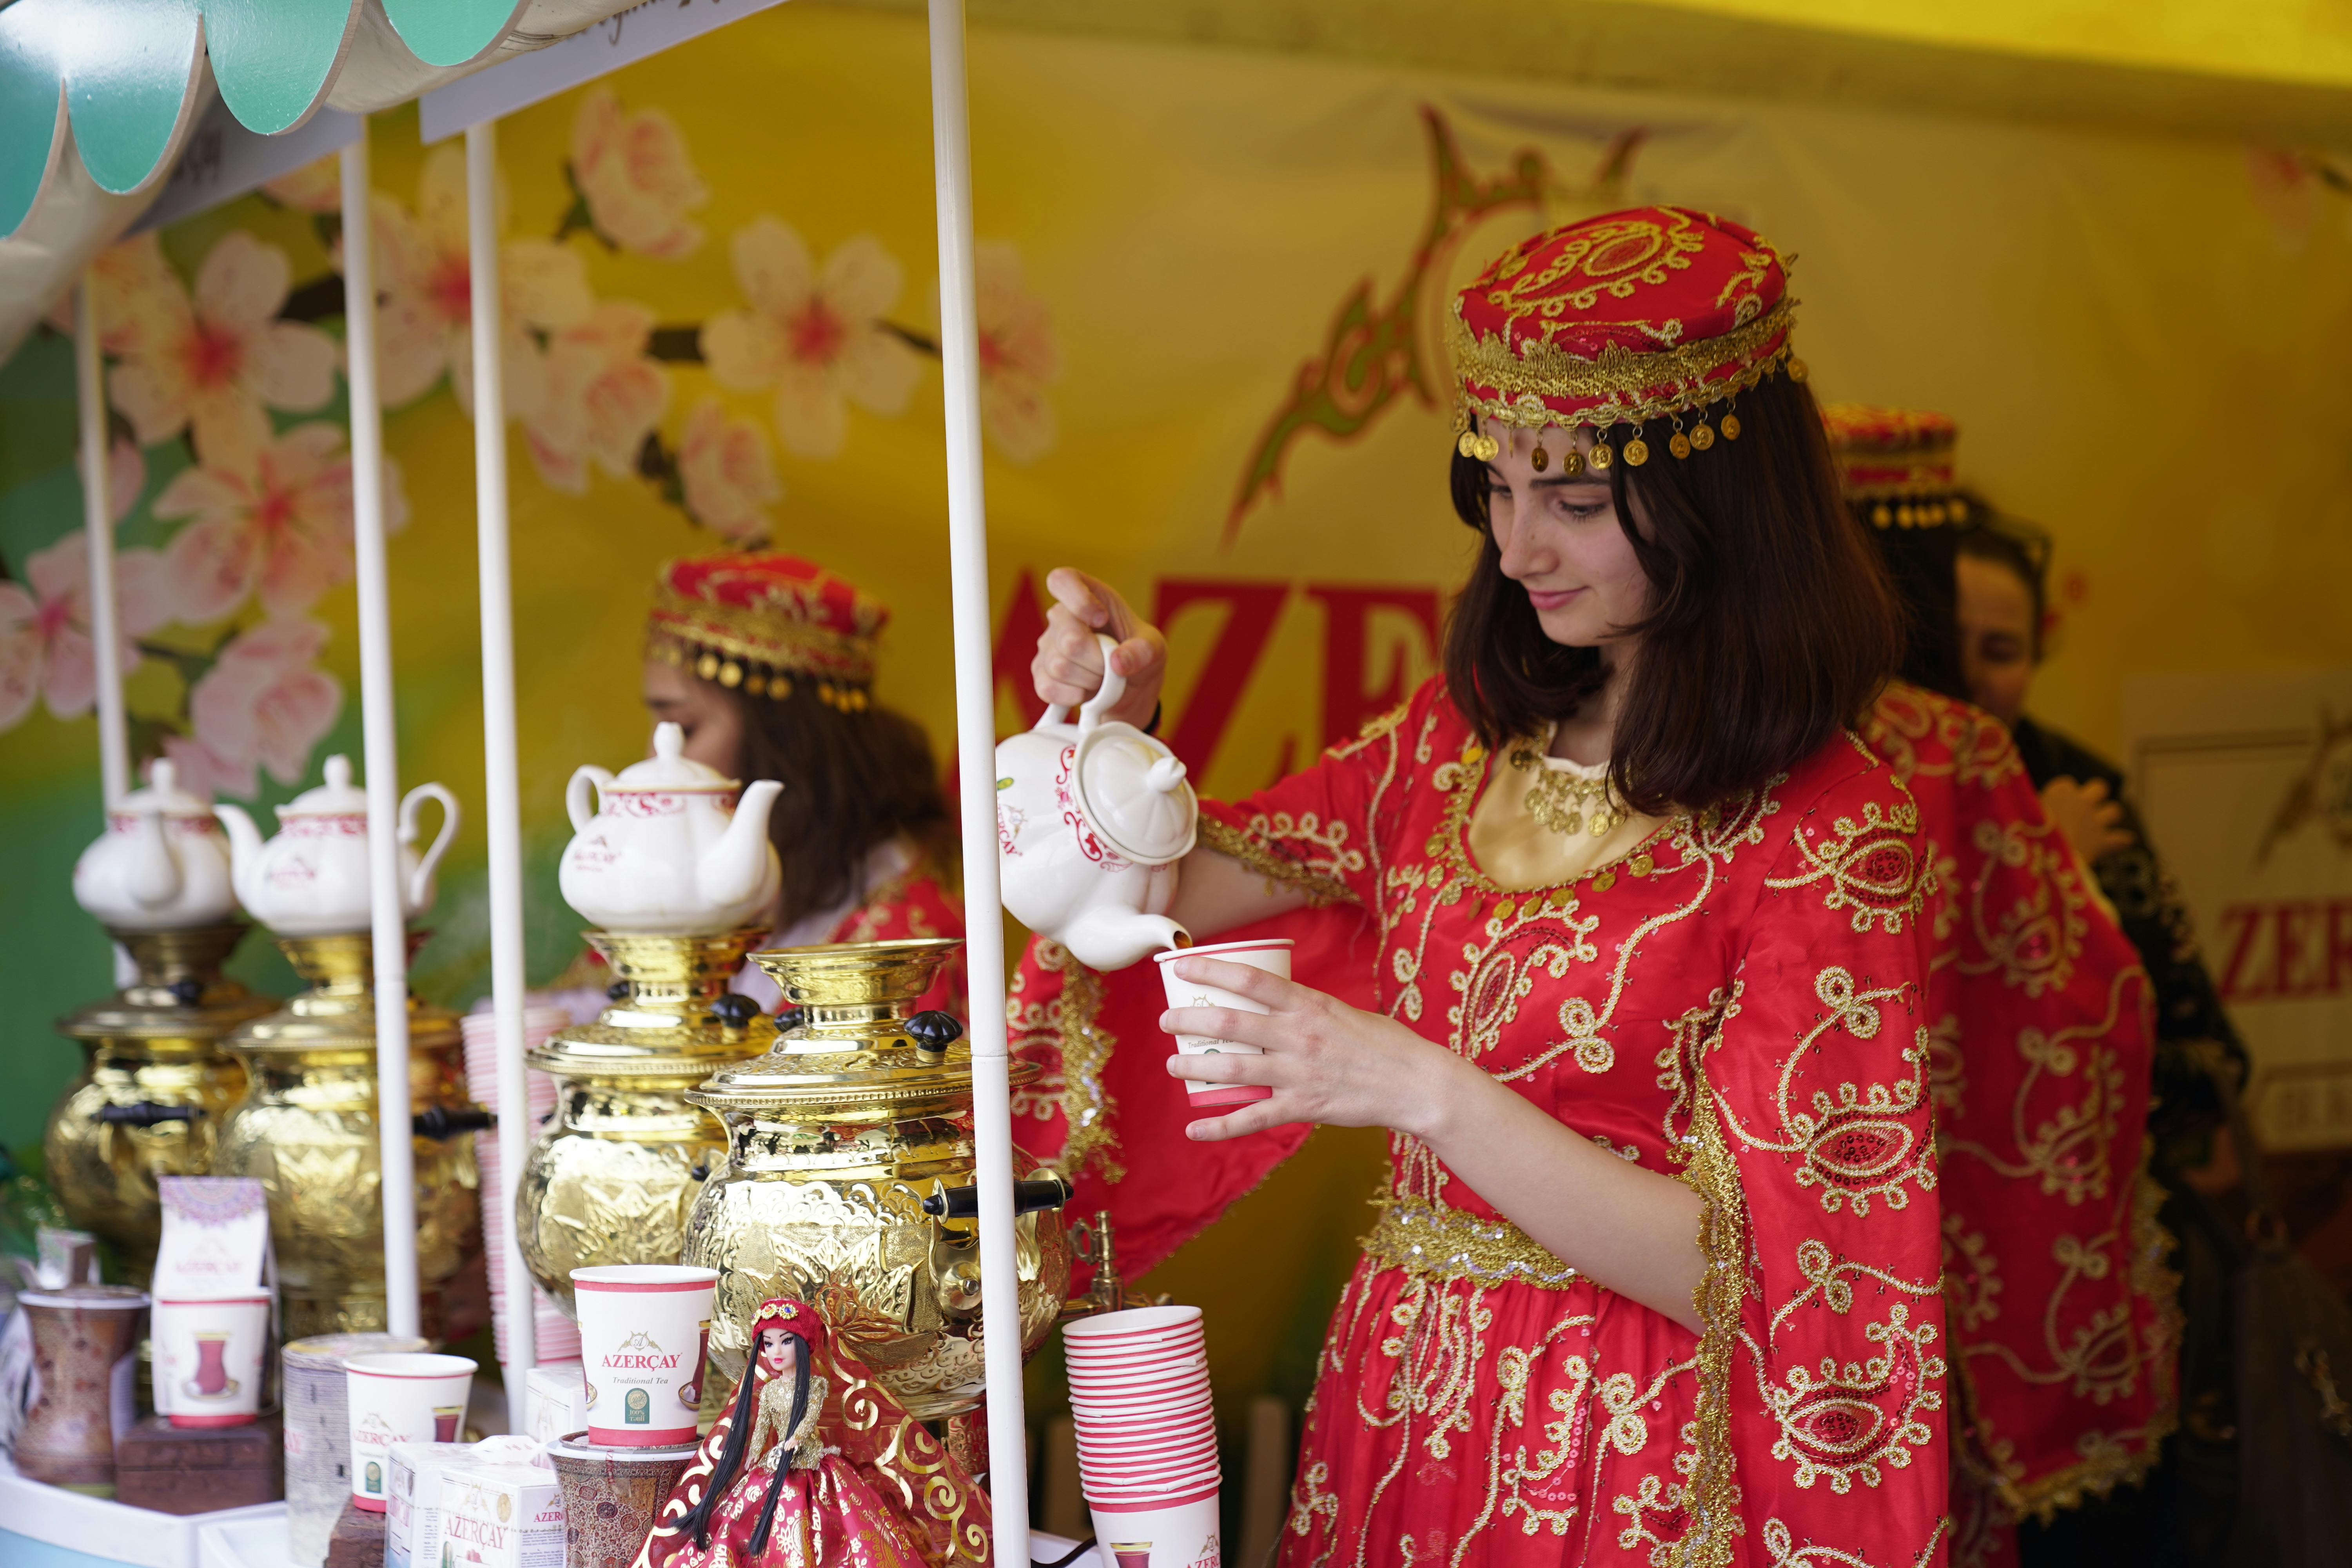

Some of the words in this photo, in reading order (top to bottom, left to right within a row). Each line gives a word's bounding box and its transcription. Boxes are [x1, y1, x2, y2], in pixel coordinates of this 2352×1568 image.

[1188, 1039, 1219, 1049] Traditional
[602, 1354, 681, 1372] AZERÇAY
[534, 1511, 563, 1522] AZER
